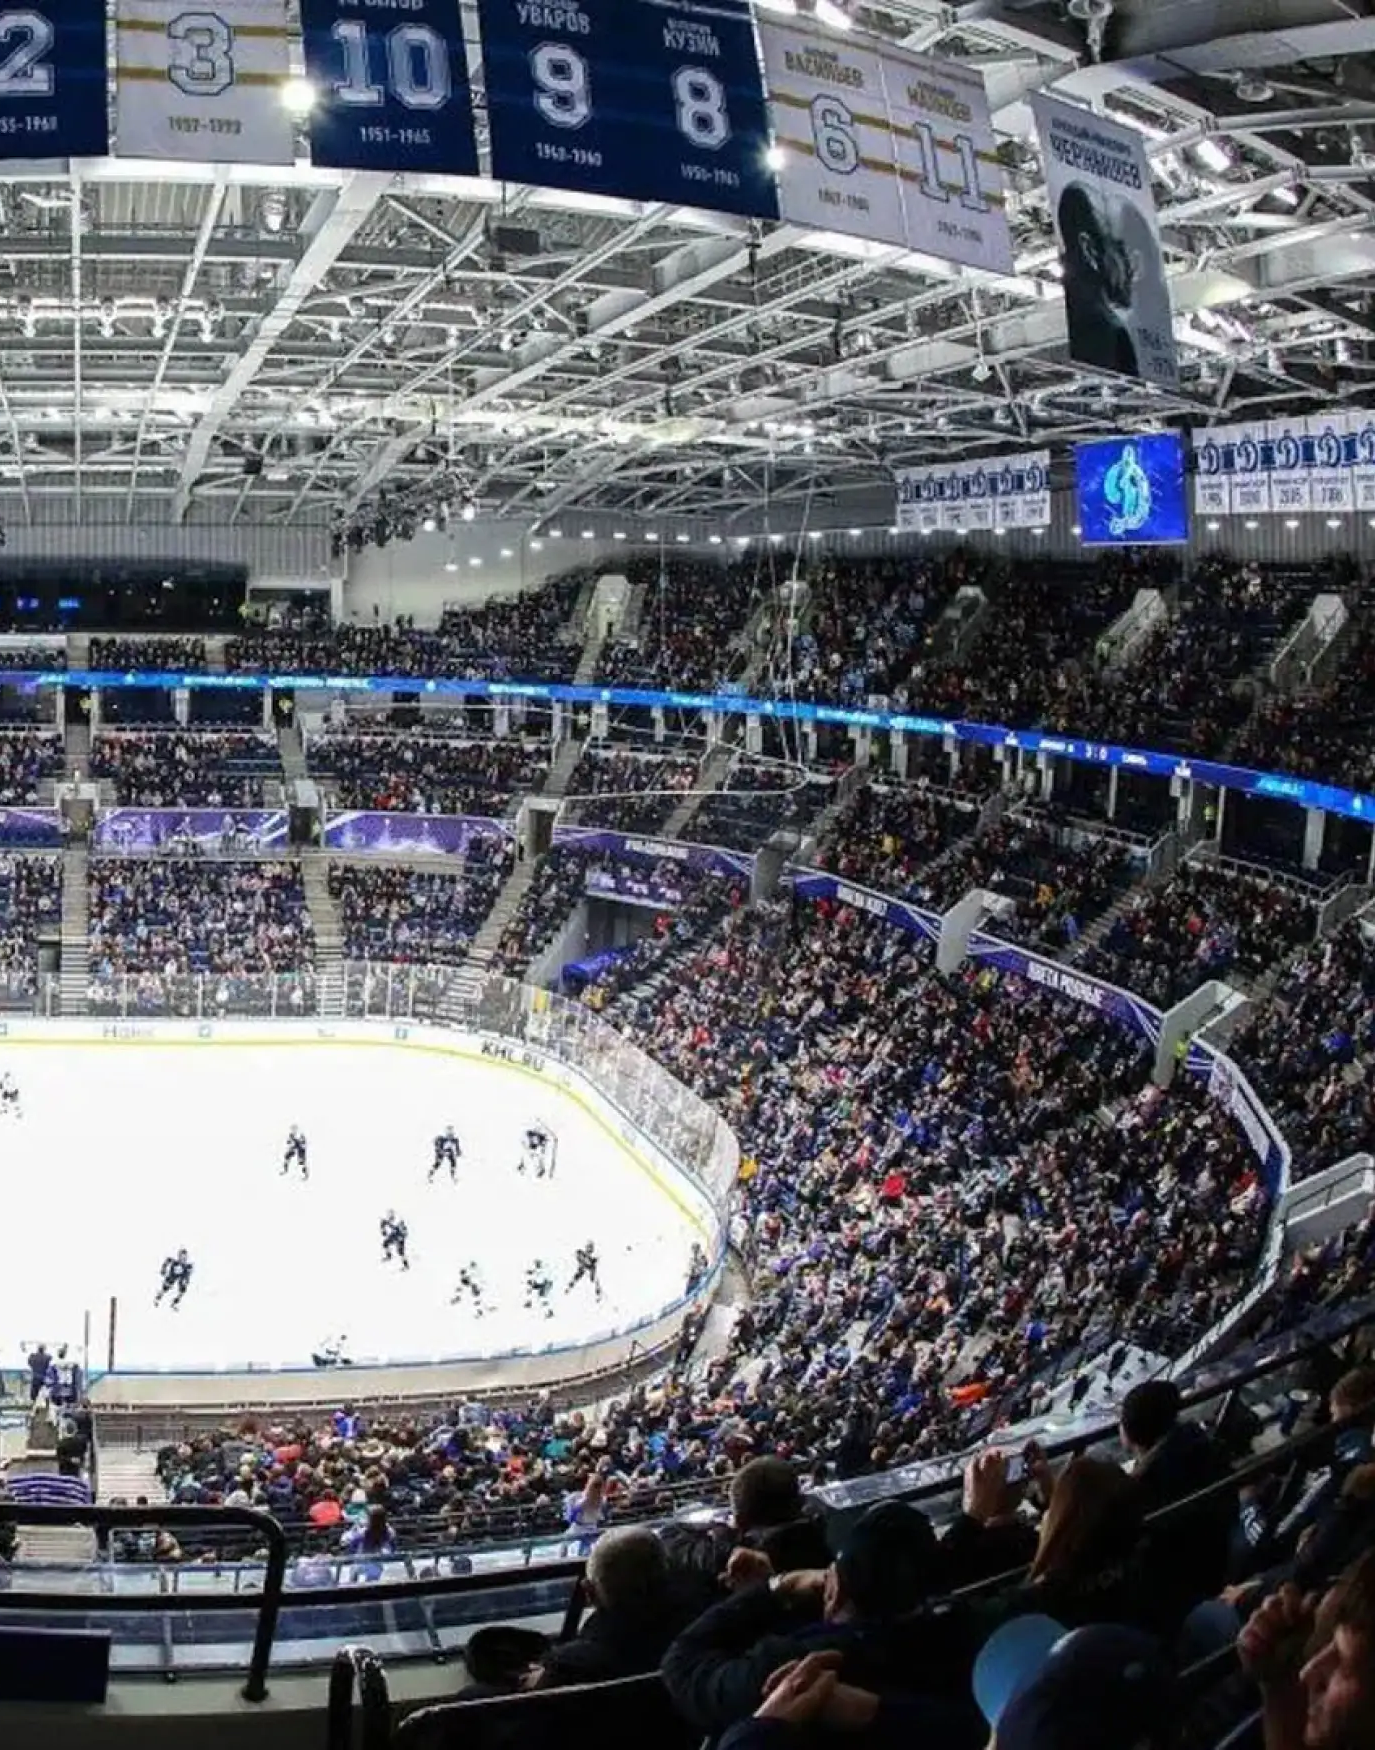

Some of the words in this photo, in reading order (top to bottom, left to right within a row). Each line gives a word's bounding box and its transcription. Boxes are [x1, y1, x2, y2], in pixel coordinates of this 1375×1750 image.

[166, 11, 234, 96] 3
[330, 18, 452, 110] 10
[528, 40, 593, 130] 9
[670, 64, 733, 150] 8
[809, 93, 860, 176] 6
[912, 120, 991, 214] 11
